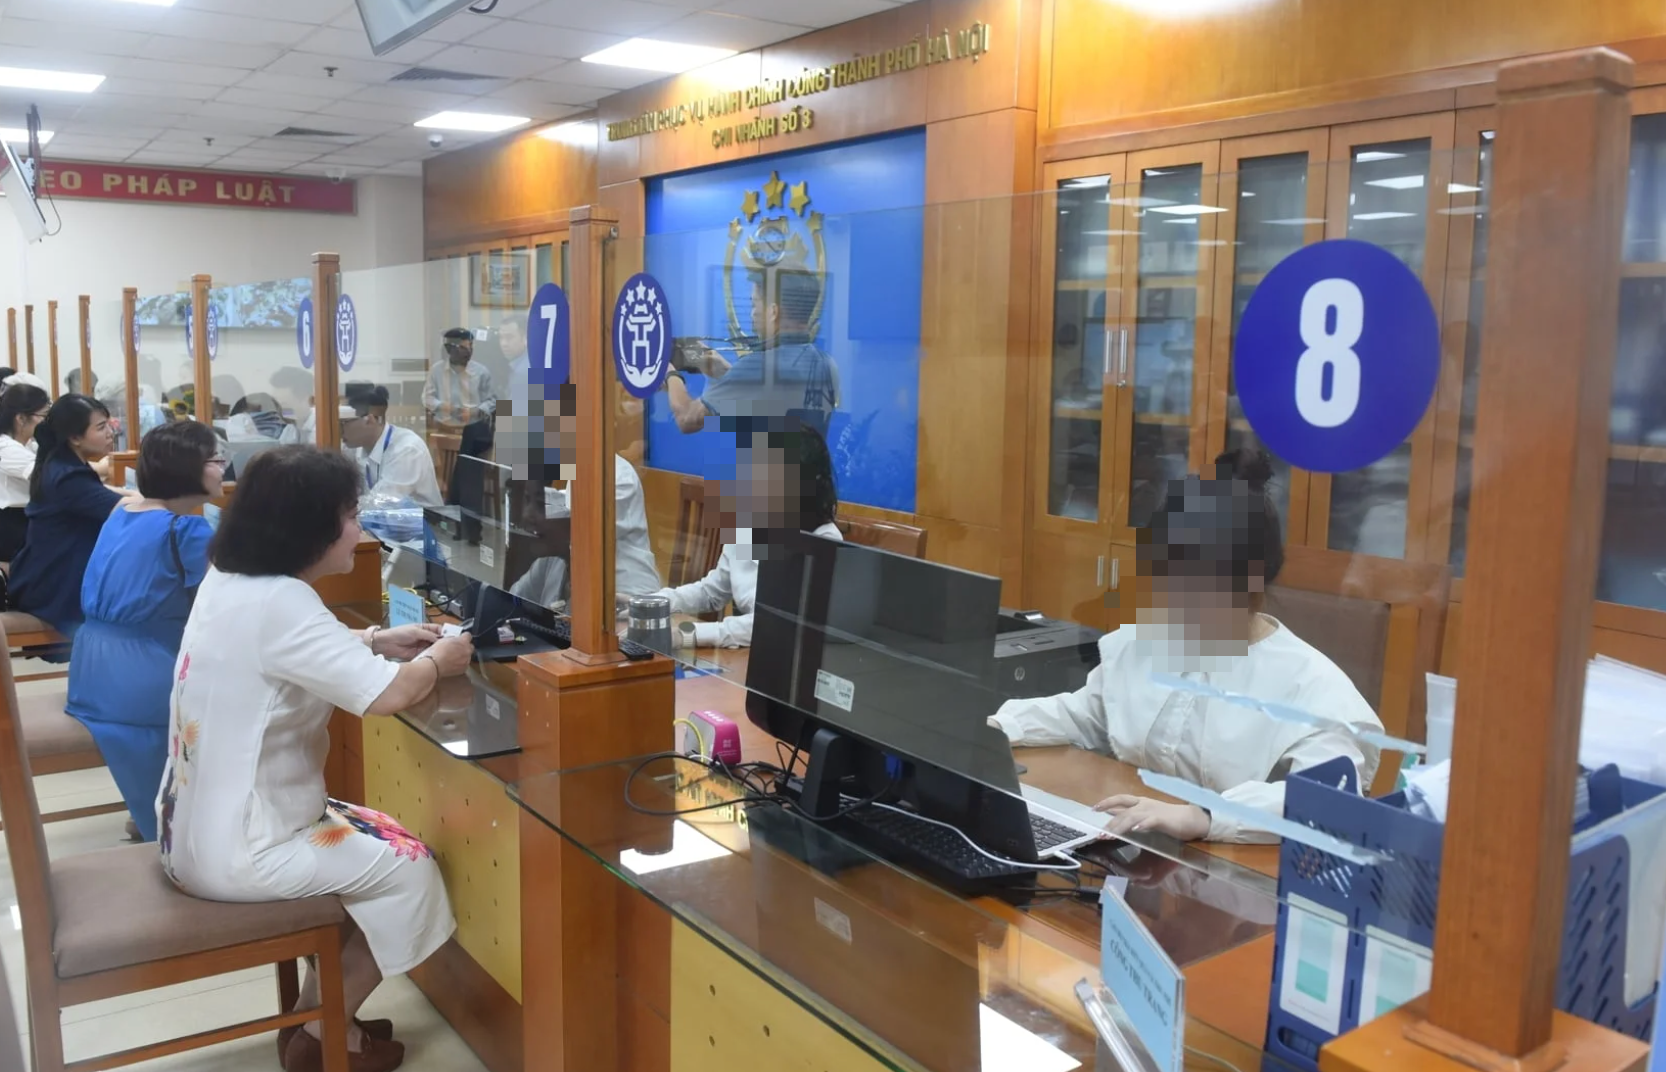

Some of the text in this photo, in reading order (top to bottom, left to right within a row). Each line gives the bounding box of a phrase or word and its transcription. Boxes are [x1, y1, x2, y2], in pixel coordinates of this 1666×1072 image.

[658, 103, 687, 133] PHỤC
[689, 97, 705, 126] VỤ
[706, 88, 743, 118] HÀNH
[744, 77, 787, 110] CHÍNH
[787, 66, 830, 98] CÔNG
[829, 52, 882, 88] THÀNH
[883, 32, 921, 75] PHỐ
[924, 27, 952, 66] HÀ
[957, 20, 991, 62] NỘI
[711, 104, 814, 149] CHI NHÁNH SỐ 3
[39, 169, 296, 206] EO PHÁP LUẬT
[303, 310, 312, 357] 6
[540, 304, 558, 369] 7
[1295, 277, 1365, 428] 8
